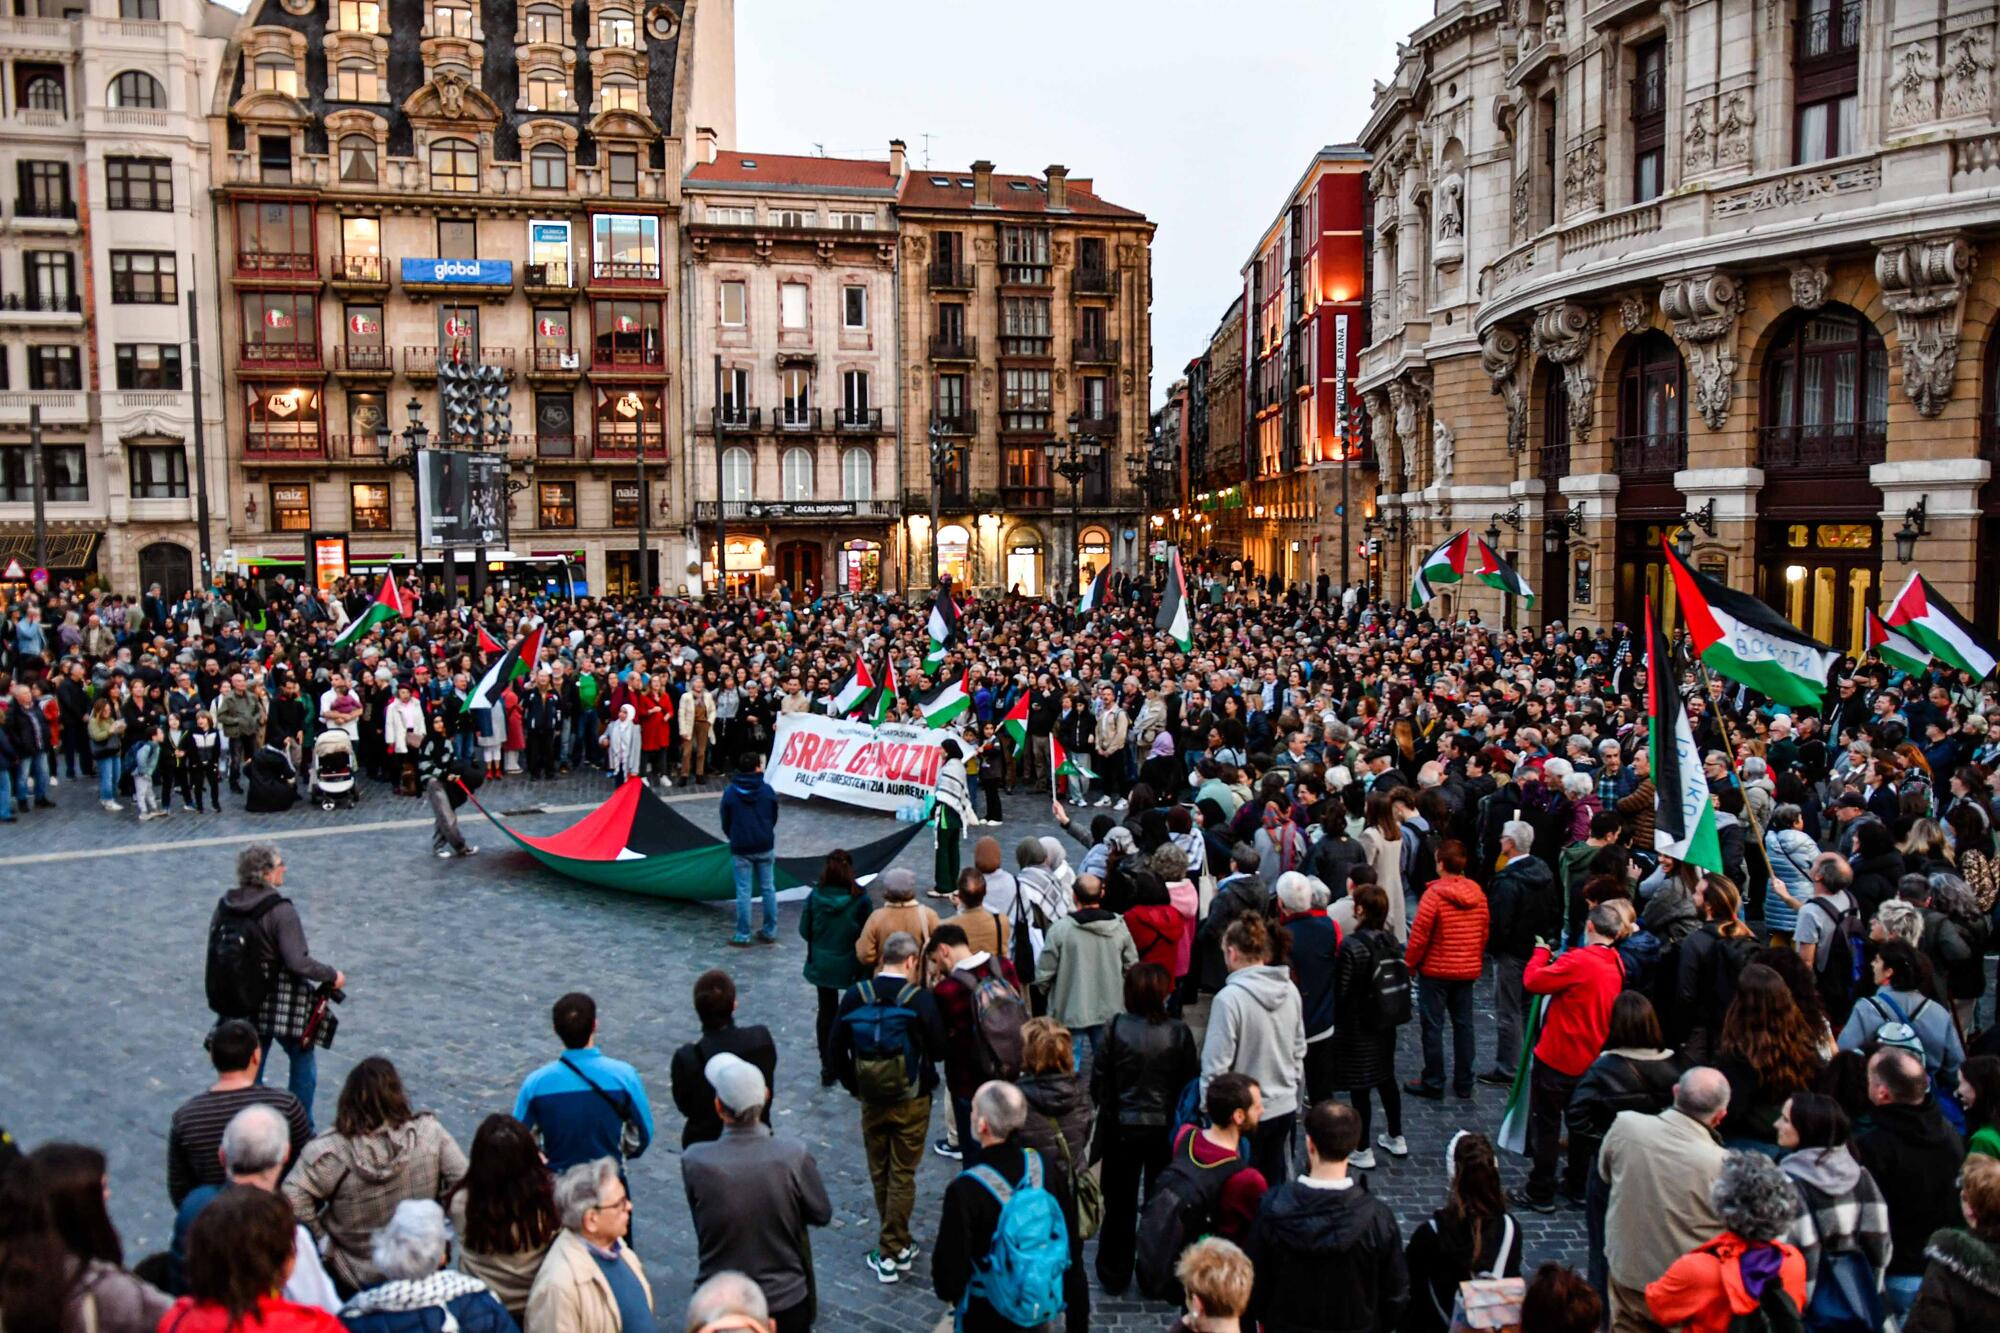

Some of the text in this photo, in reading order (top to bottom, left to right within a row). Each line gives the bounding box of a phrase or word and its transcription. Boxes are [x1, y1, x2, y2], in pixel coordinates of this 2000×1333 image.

[434, 261, 480, 280] global
[362, 322, 379, 333] EA
[457, 327, 472, 336] EA
[550, 326, 566, 336] EA
[274, 397, 291, 408] BG
[360, 409, 377, 421] BG
[275, 488, 302, 500] naiz
[616, 486, 639, 498] naiz
[794, 505, 816, 513] LOCAL
[779, 731, 850, 772] ISRAEL
